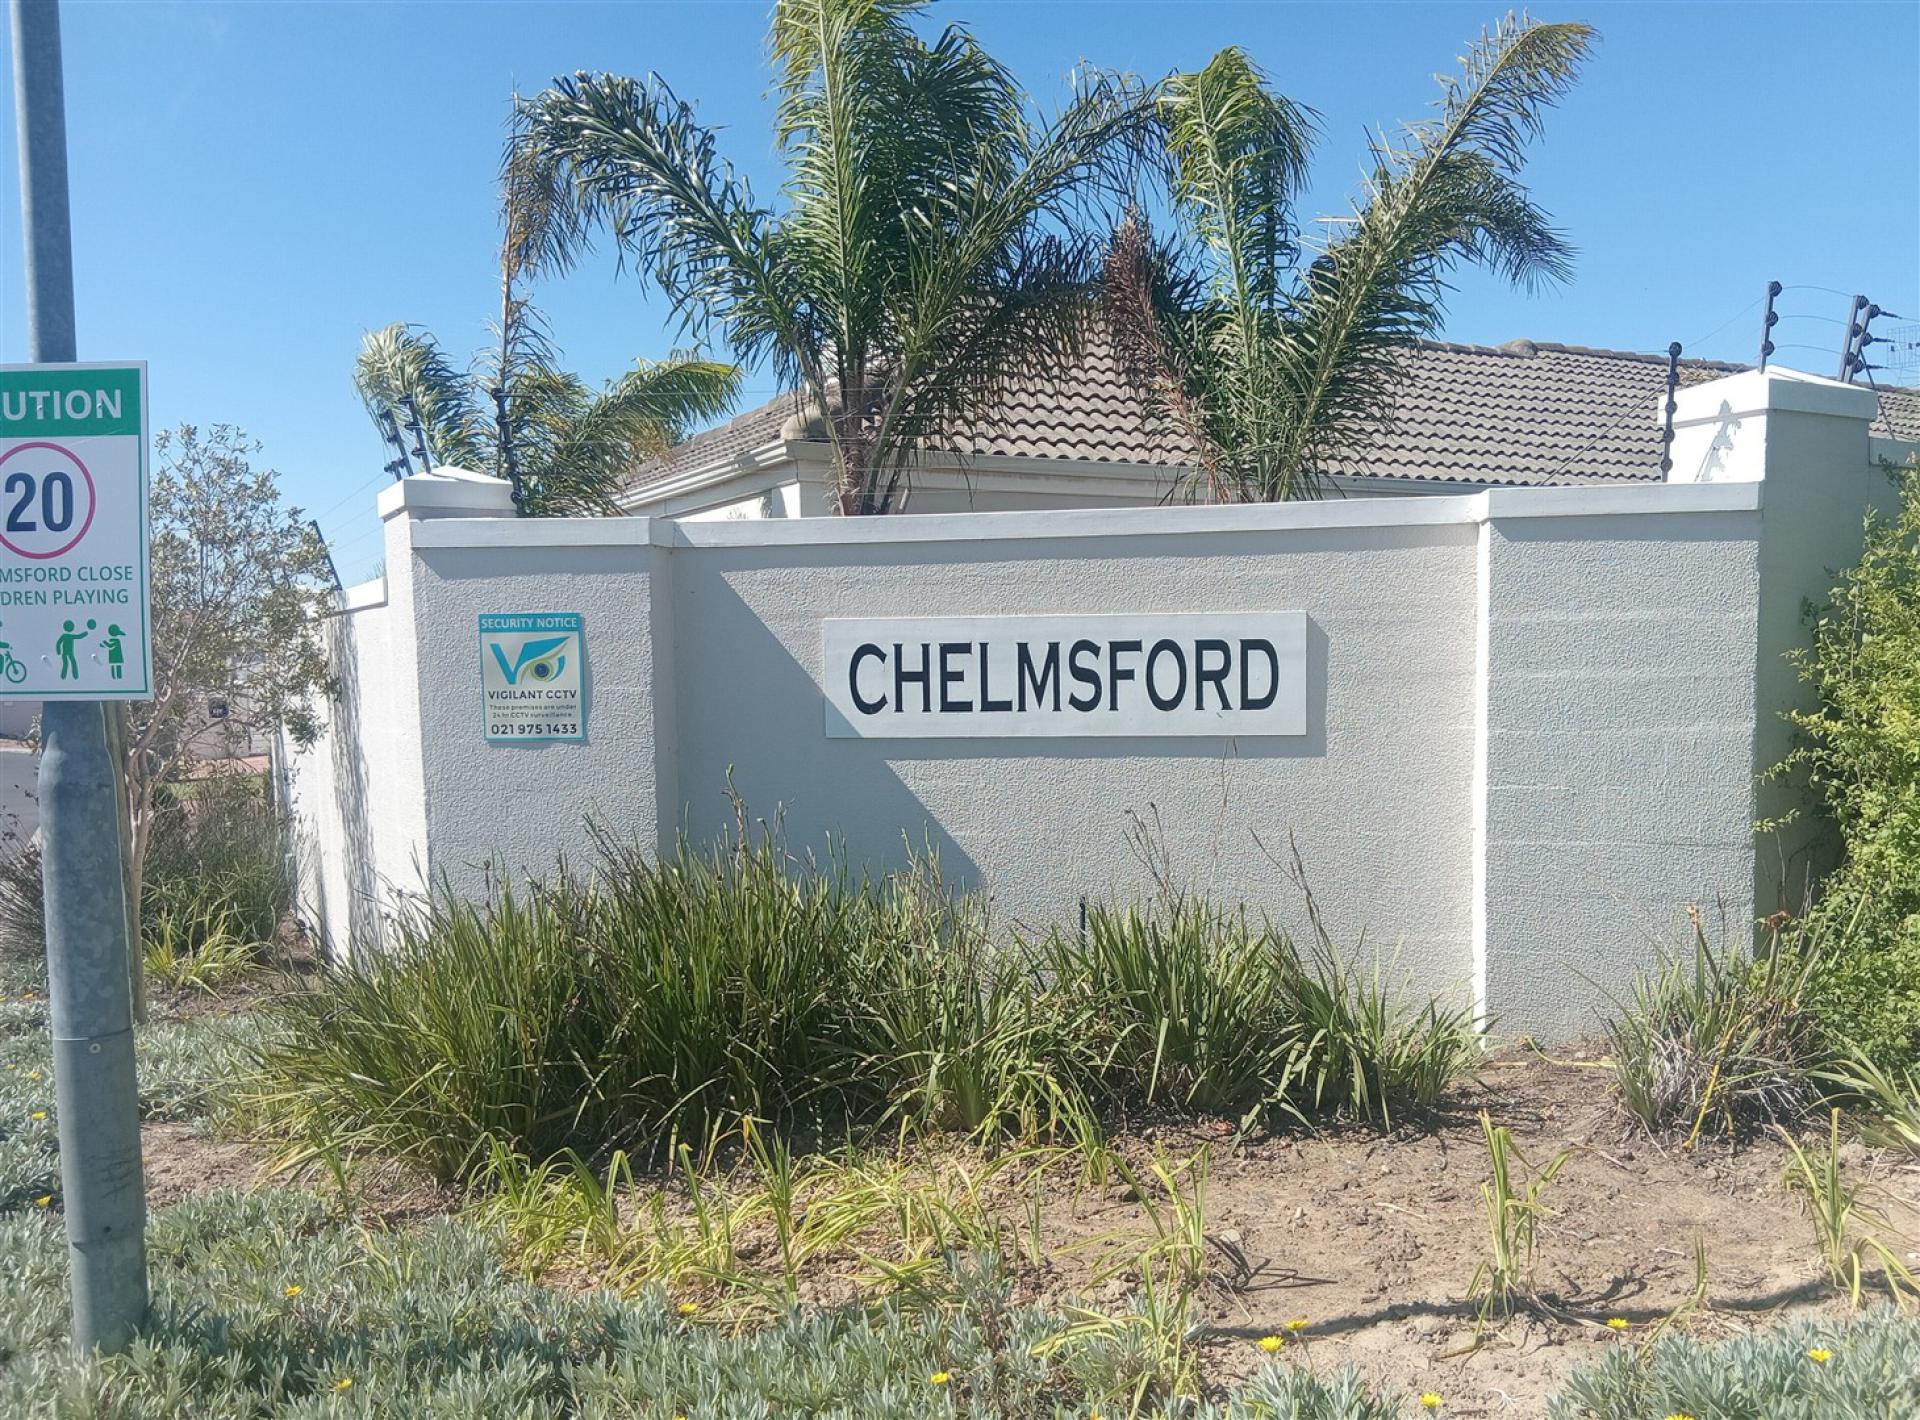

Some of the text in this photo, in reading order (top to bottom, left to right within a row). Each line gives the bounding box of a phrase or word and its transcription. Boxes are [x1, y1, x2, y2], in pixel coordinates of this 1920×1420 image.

[3, 389, 122, 421] UTION
[5, 471, 74, 532] 20
[77, 566, 133, 581] CLOSE
[0, 588, 129, 606] DREN PLAYING
[481, 617, 577, 629] SECURITY NOTICE
[849, 638, 1280, 715] CHELMSFORD
[488, 689, 577, 700] VIGILANT CCTV
[491, 723, 577, 735] 021 975 1433
